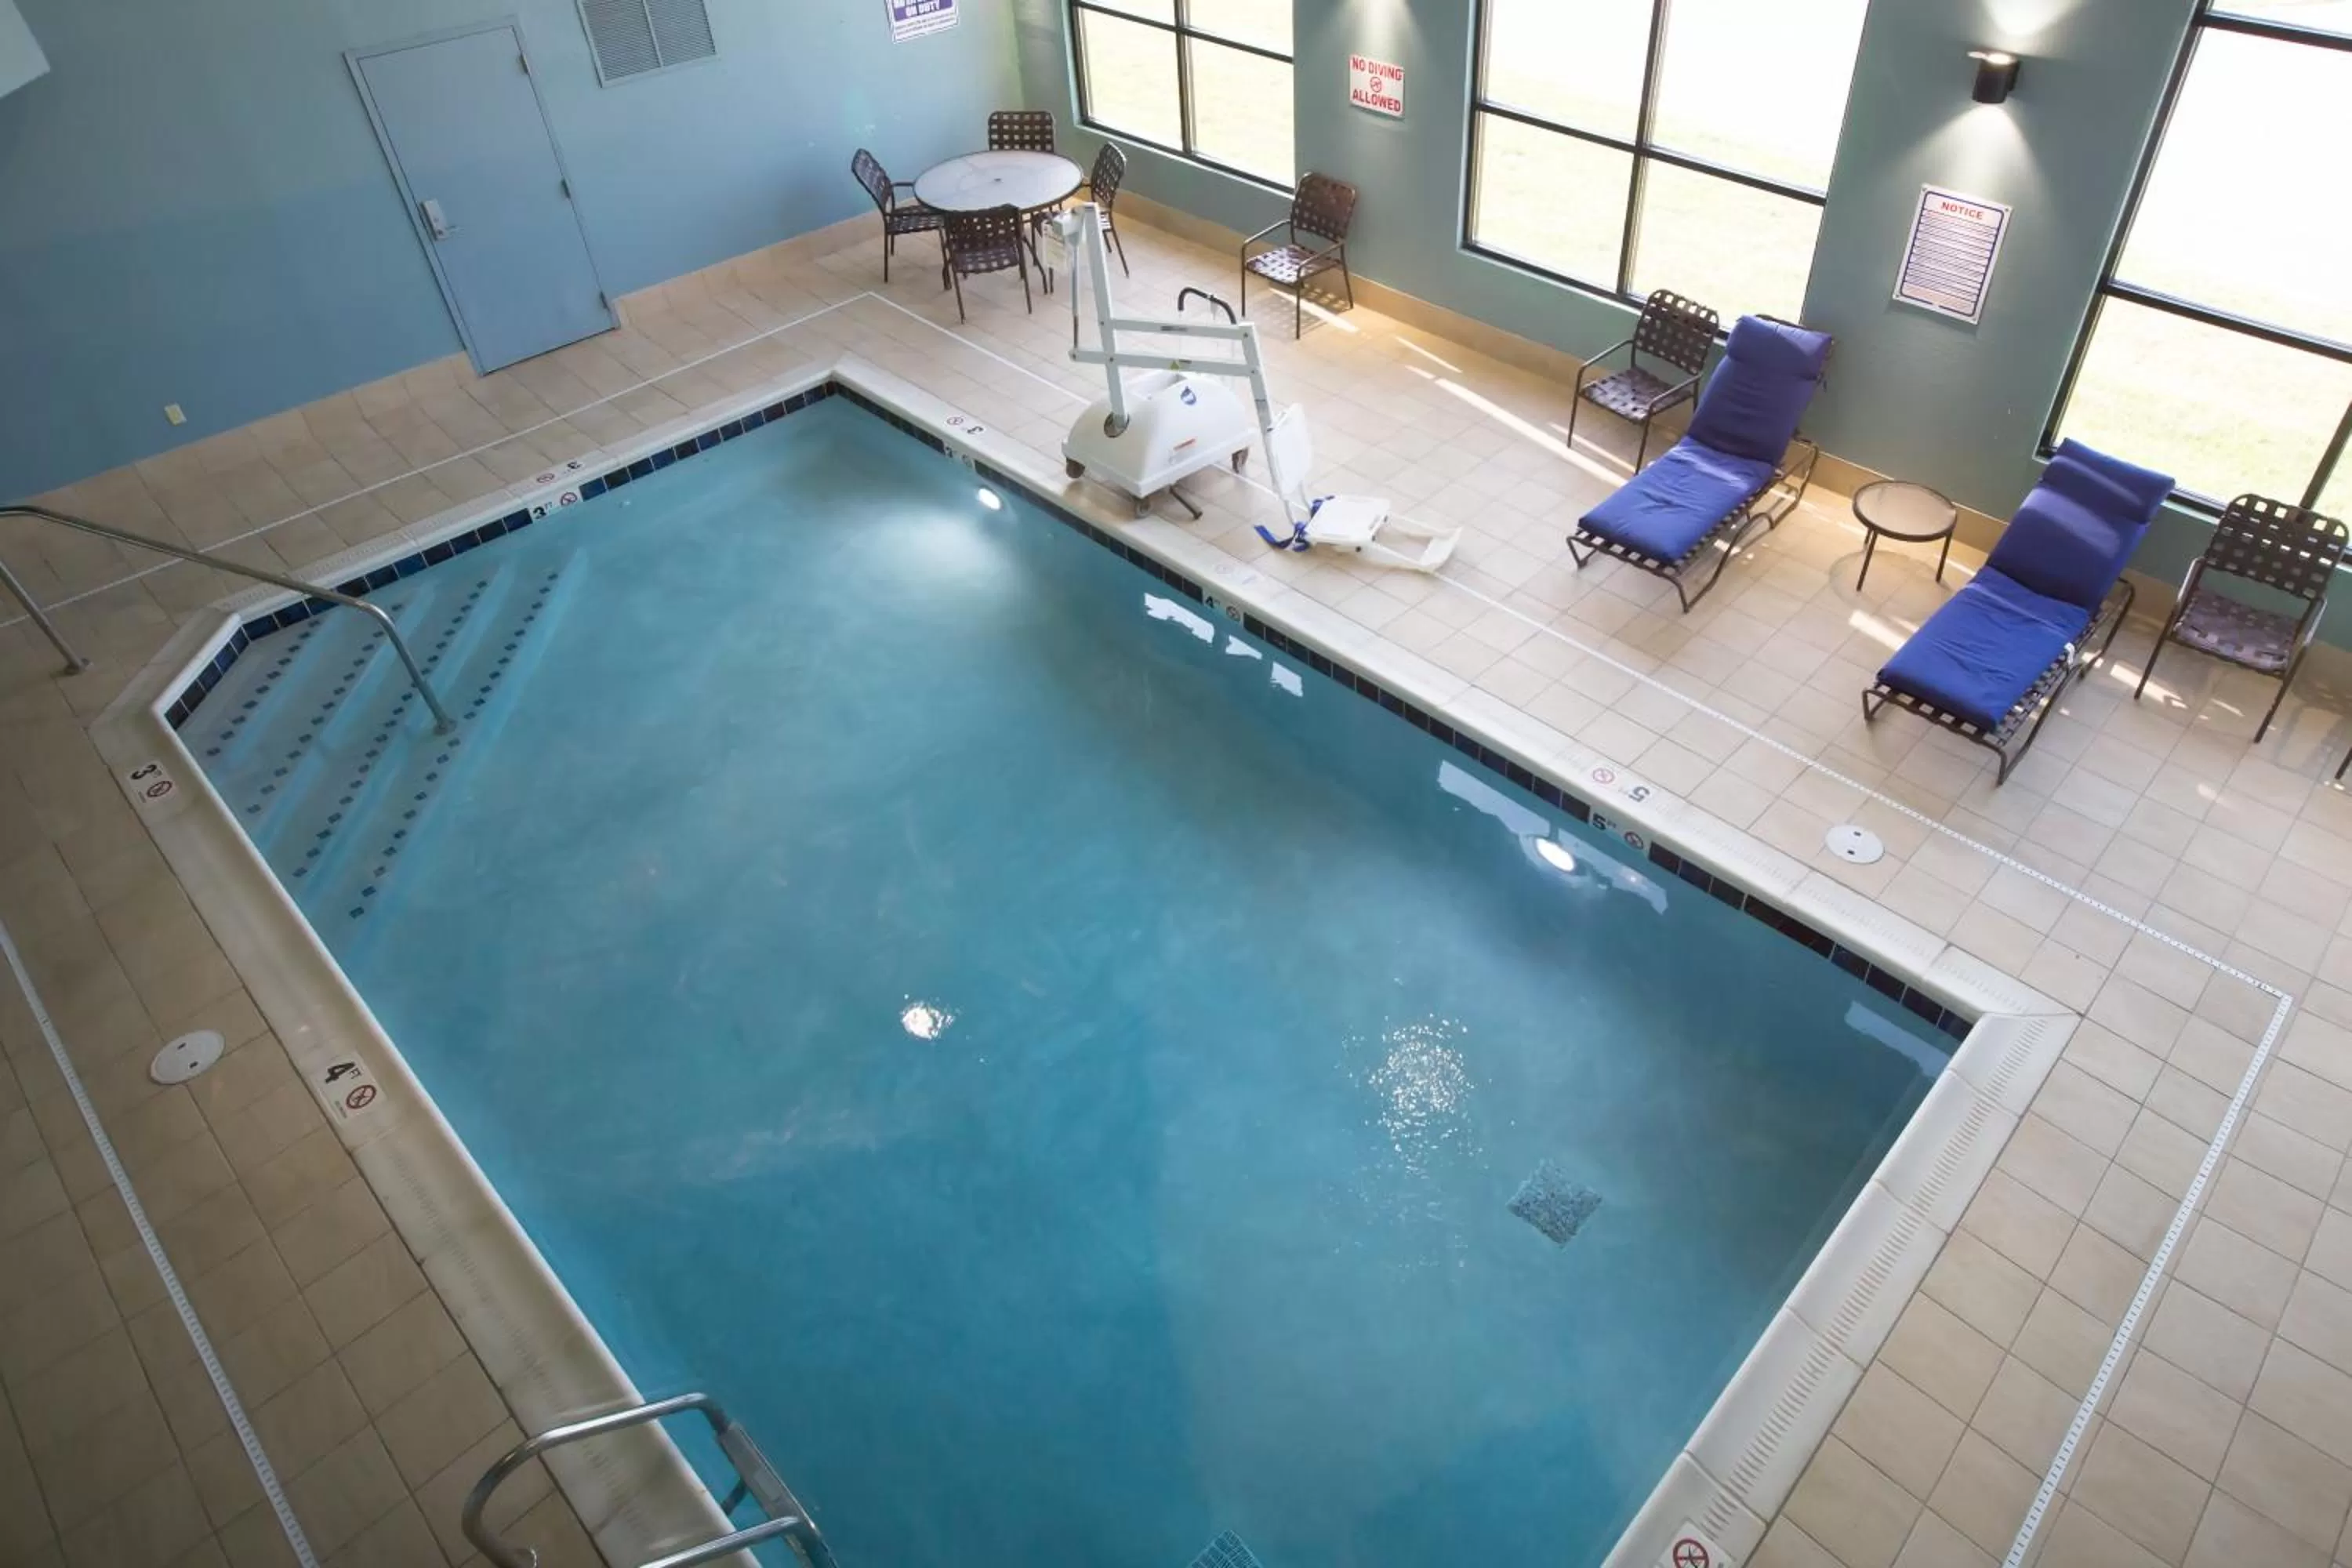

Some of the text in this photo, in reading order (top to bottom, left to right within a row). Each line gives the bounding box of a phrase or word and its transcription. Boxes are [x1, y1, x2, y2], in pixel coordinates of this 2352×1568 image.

[1352, 56, 1402, 81] NO DIVING
[1352, 89, 1401, 112] ALLOWED
[1941, 201, 1984, 220] NOTICE
